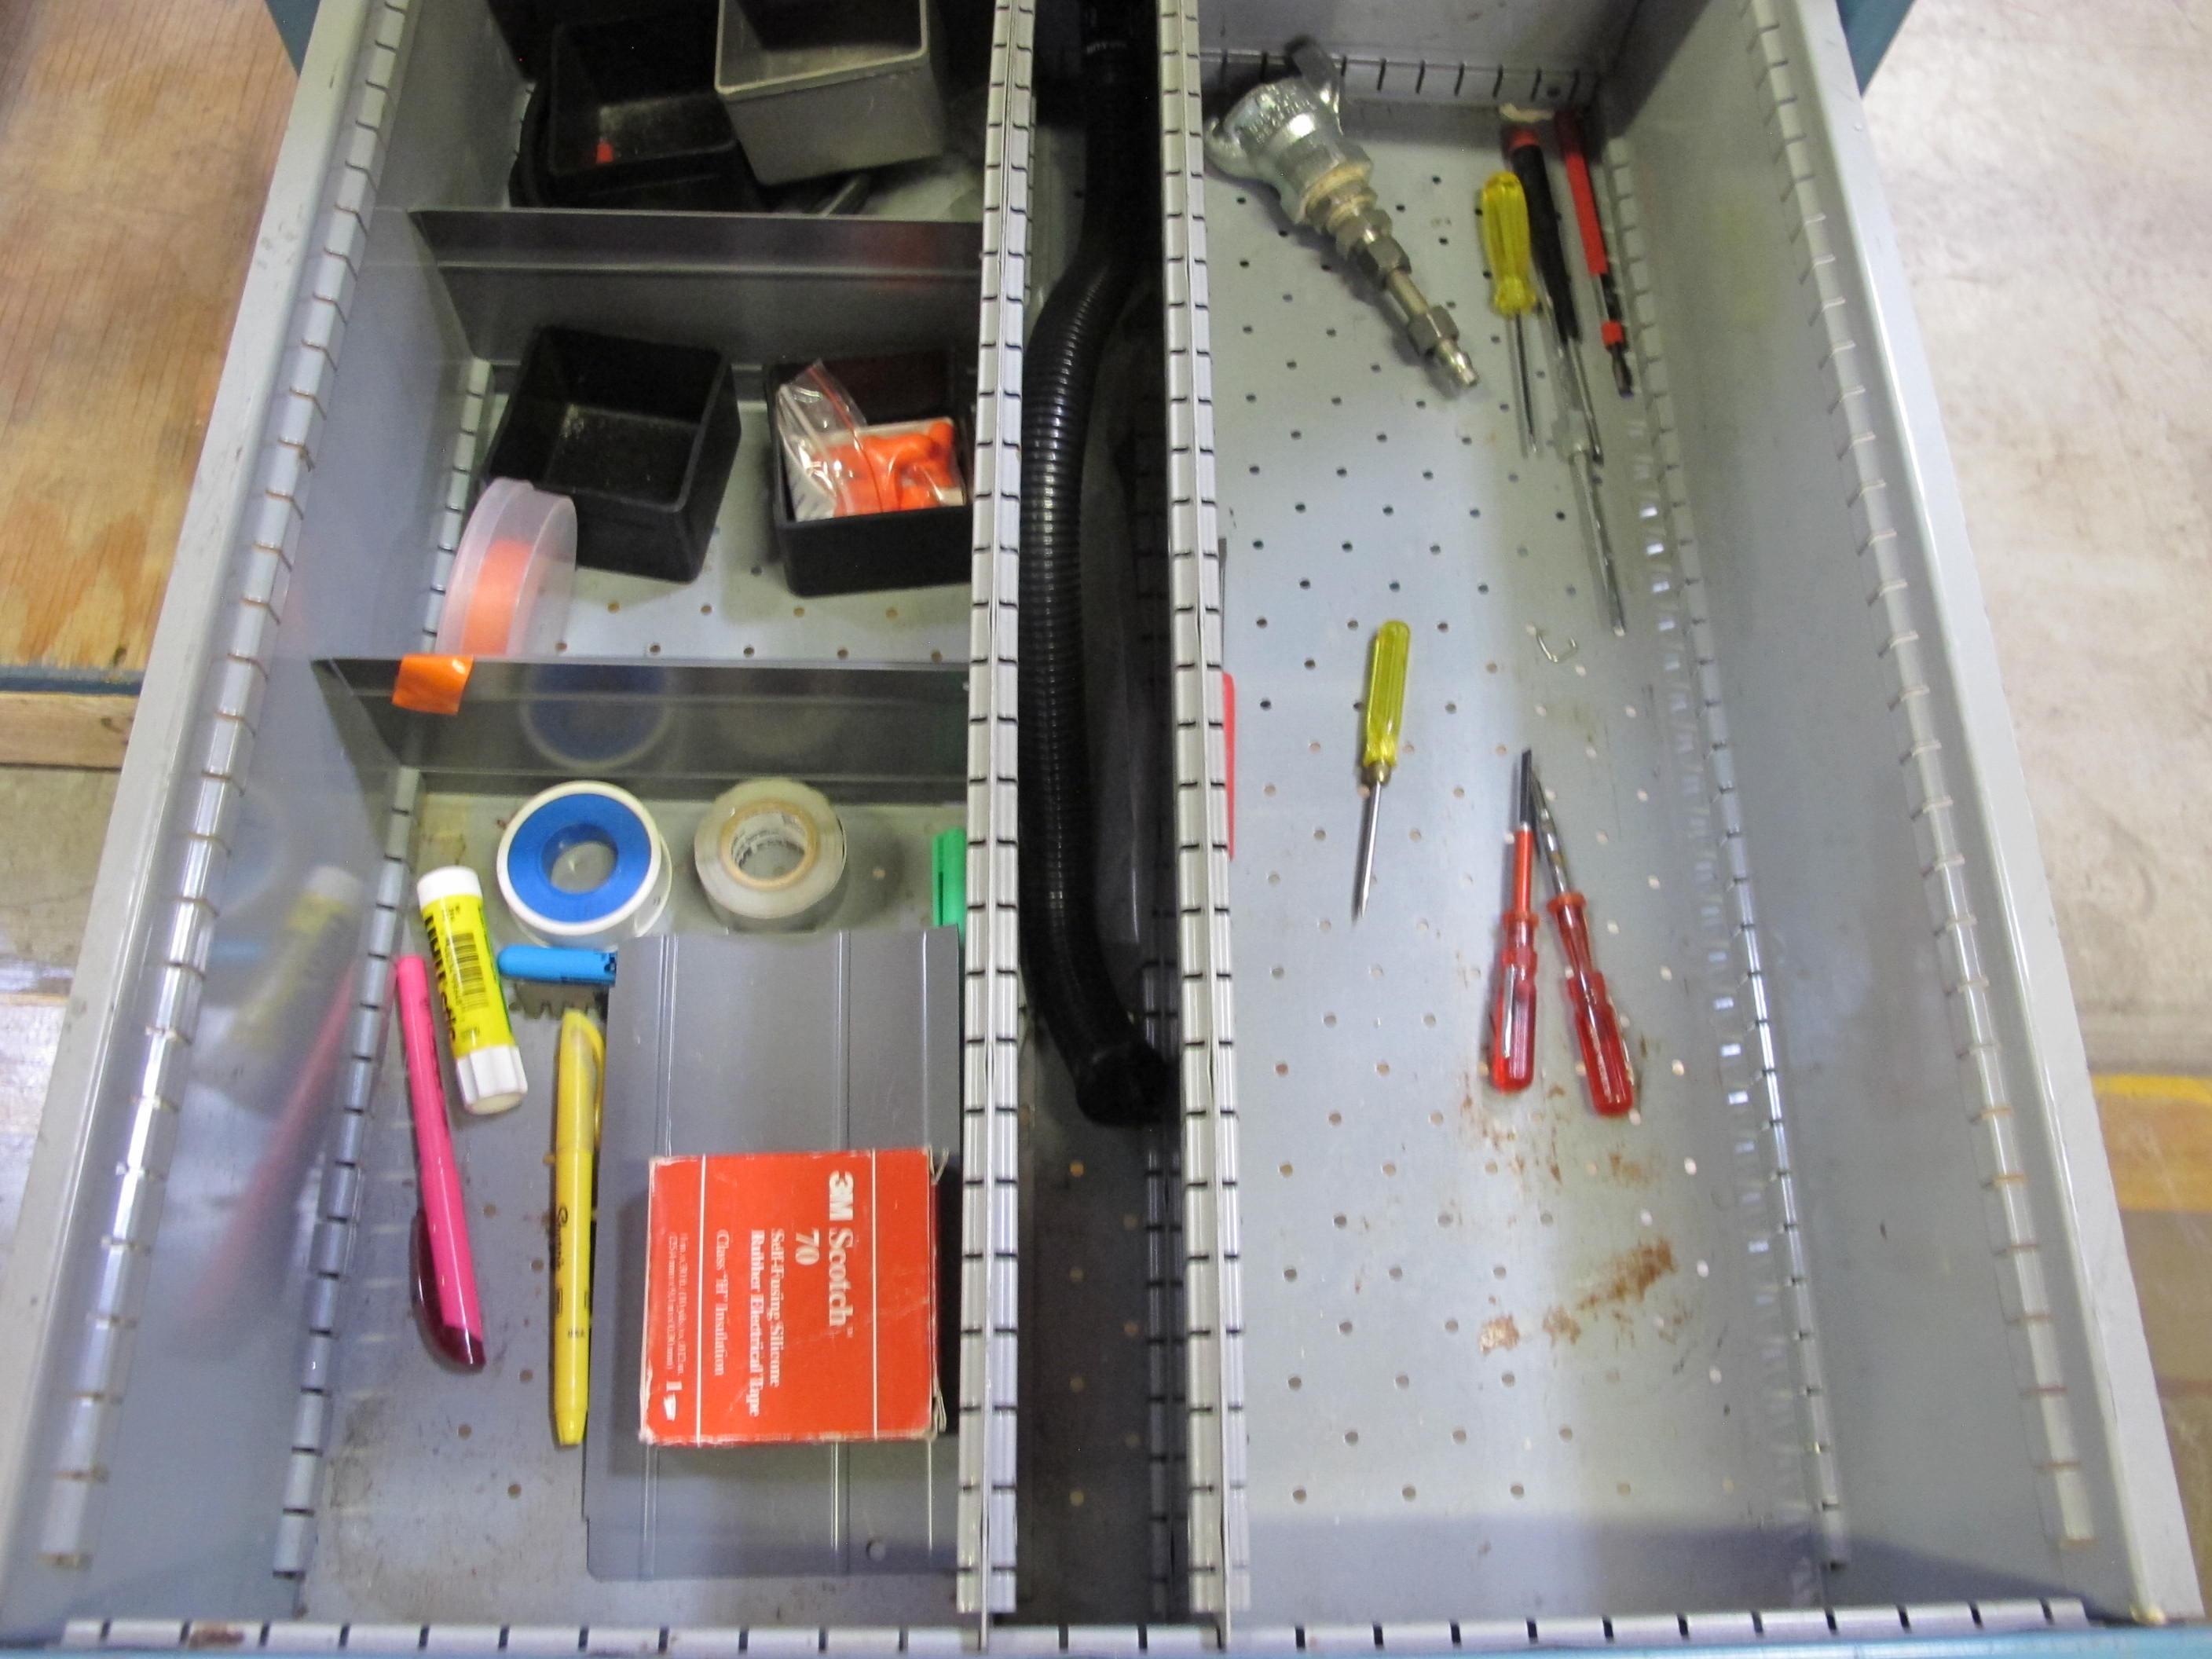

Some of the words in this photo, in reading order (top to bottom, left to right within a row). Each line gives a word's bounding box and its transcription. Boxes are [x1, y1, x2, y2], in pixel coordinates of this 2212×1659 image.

[829, 1170, 854, 1221] 3M
[716, 1229, 730, 1271] Class
[749, 1229, 765, 1291] Rubber
[767, 1229, 786, 1321] Self-Fusing
[795, 1228, 820, 1265] 70
[829, 1228, 854, 1328] Scotch
[714, 1304, 729, 1376] Insulation
[749, 1293, 764, 1373] Electrical
[769, 1323, 785, 1388] Silicone
[745, 1375, 764, 1417] Tape
